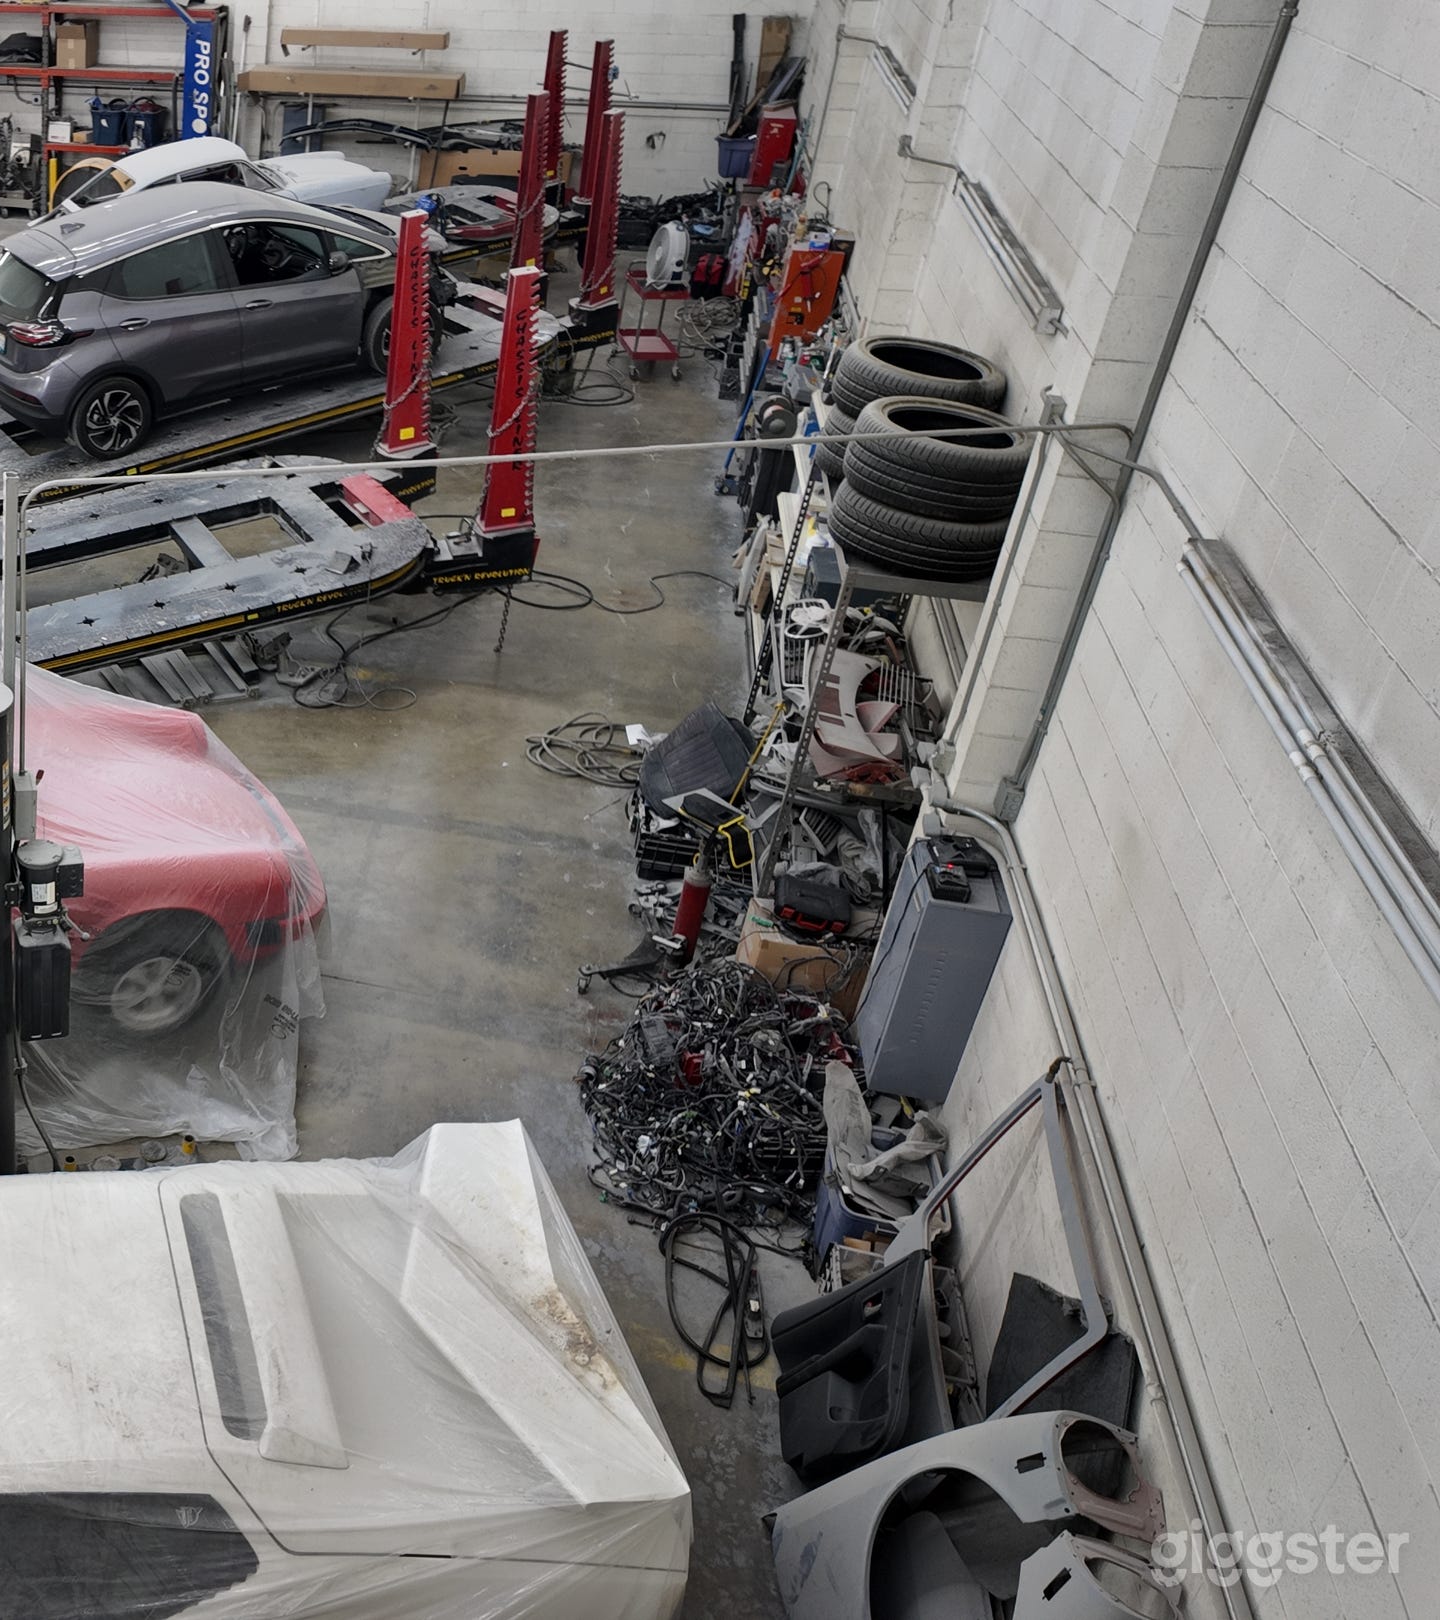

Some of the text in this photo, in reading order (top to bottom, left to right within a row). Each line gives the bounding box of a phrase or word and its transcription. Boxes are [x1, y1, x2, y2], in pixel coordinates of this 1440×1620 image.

[191, 39, 210, 138] PRO SPO
[515, 309, 527, 399] CHASSIS
[474, 567, 530, 580] REVOLUTION
